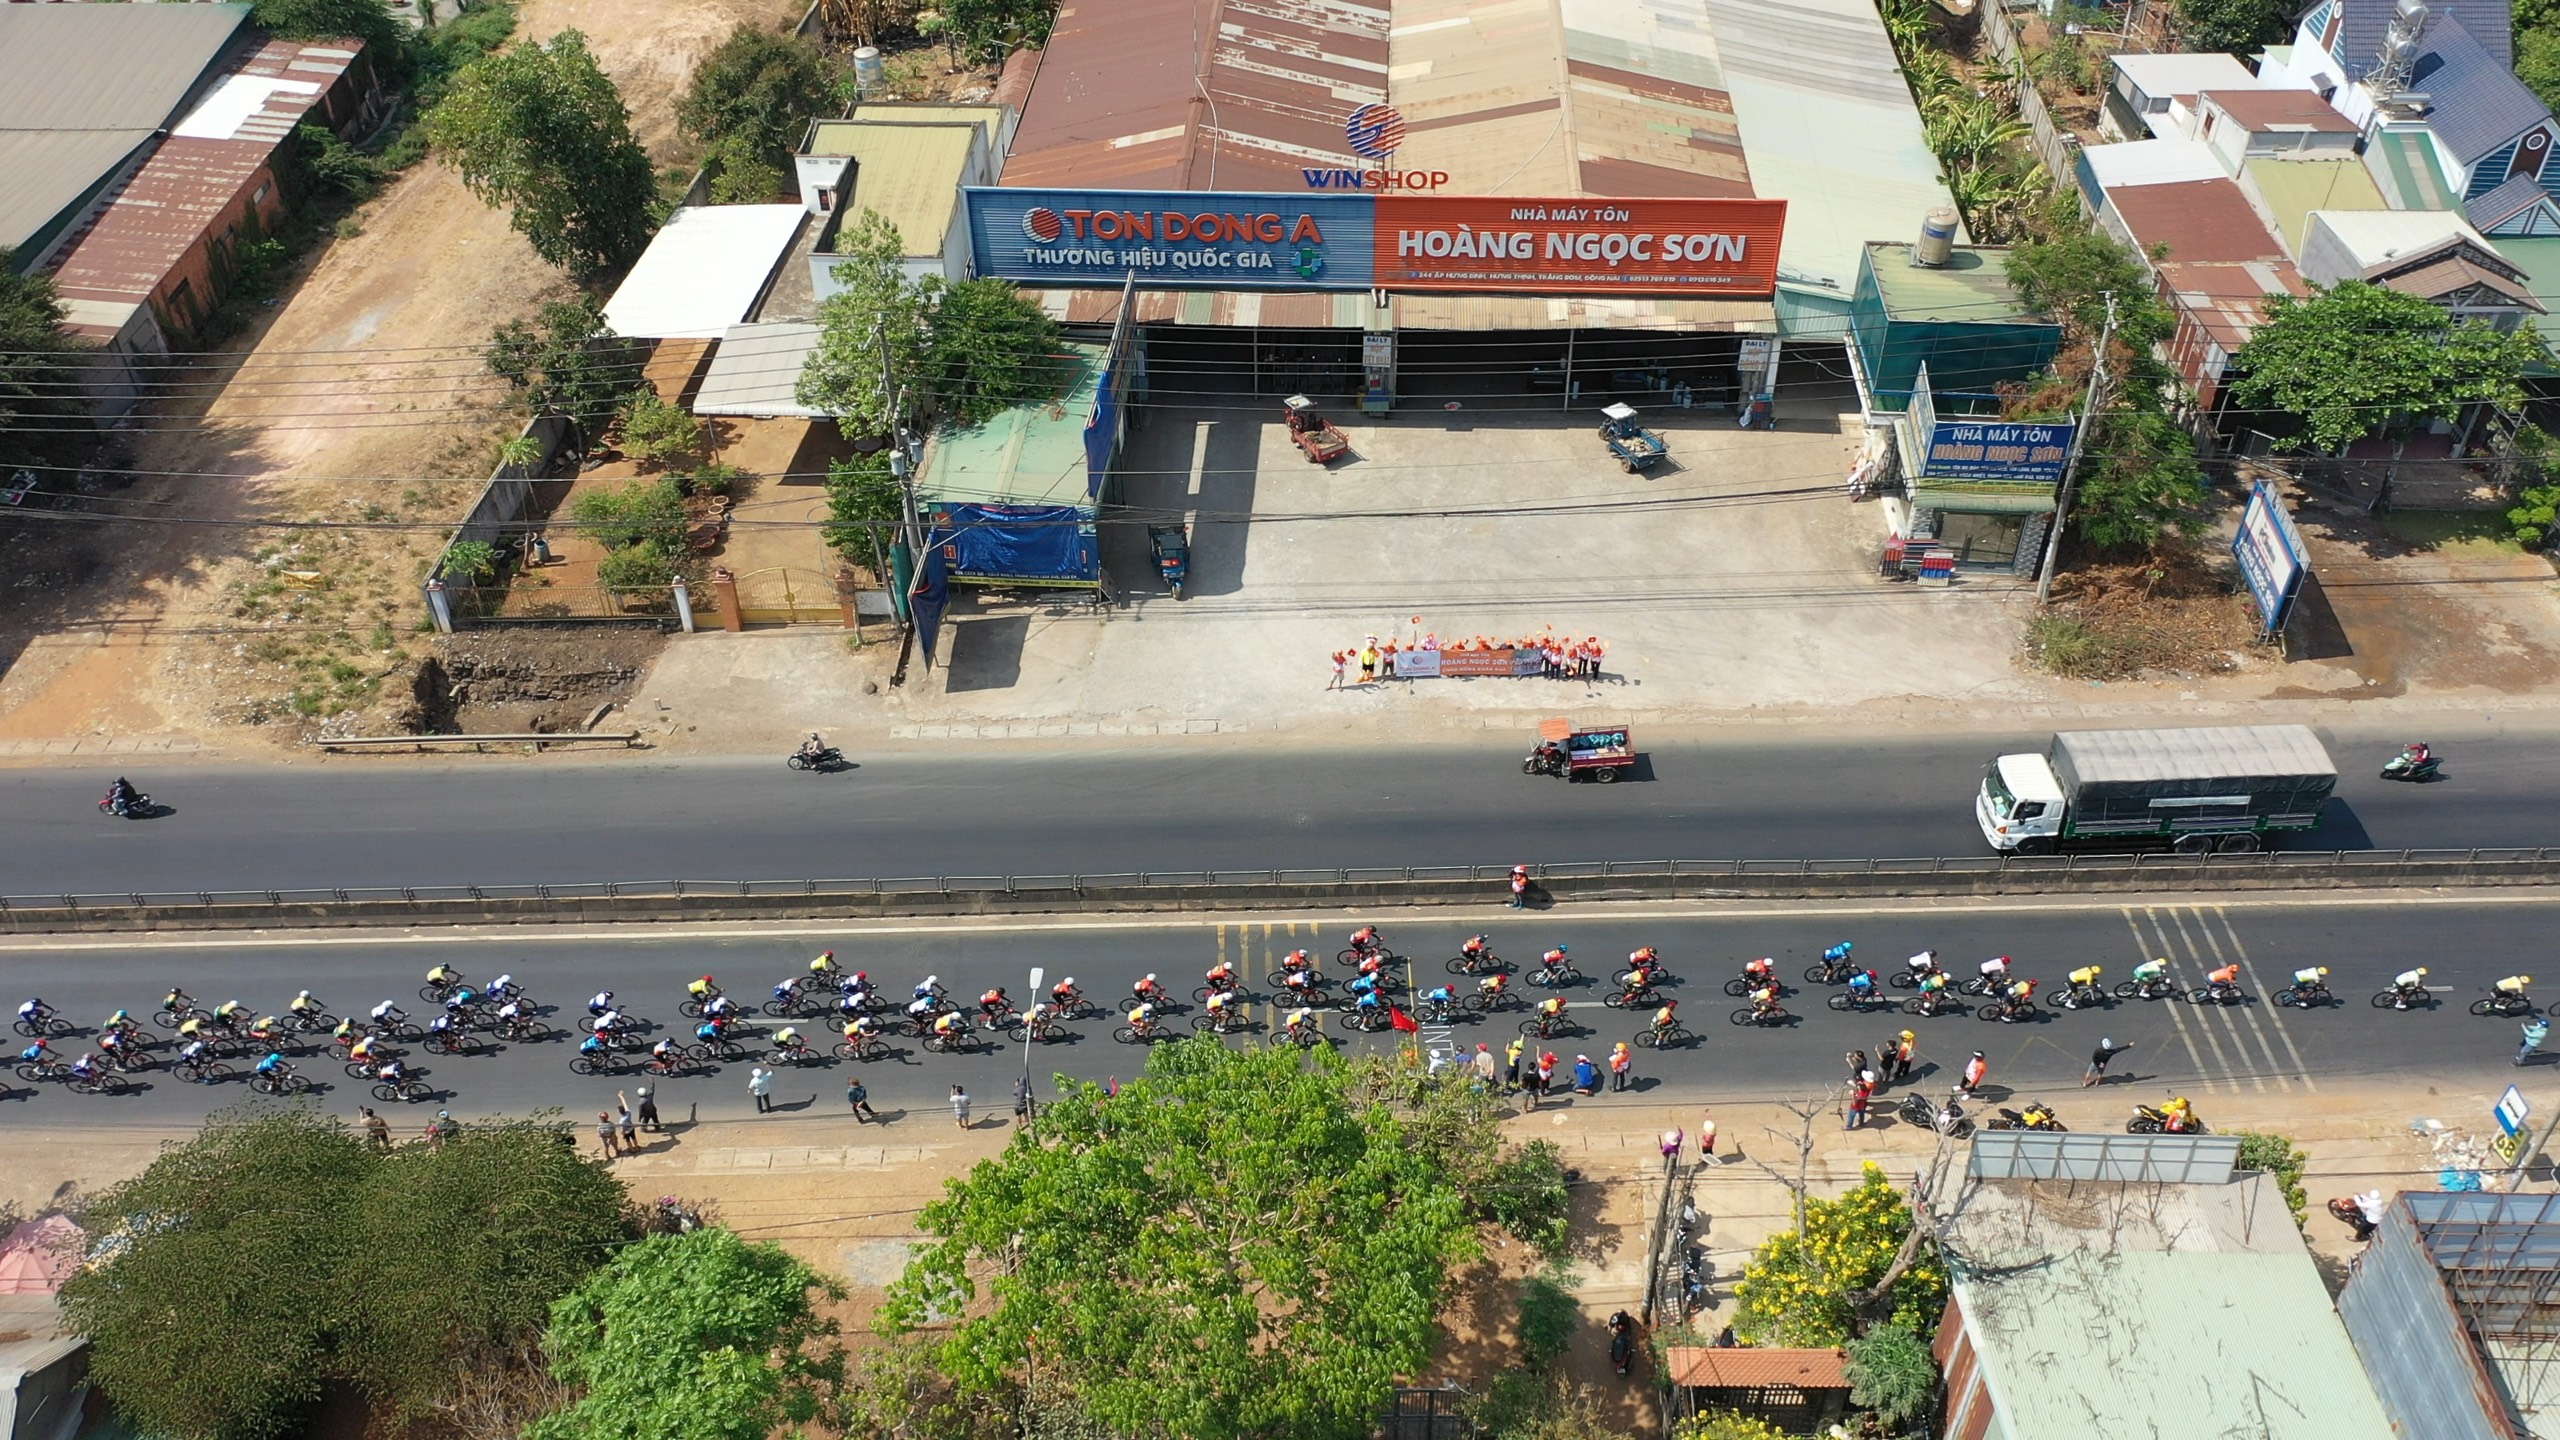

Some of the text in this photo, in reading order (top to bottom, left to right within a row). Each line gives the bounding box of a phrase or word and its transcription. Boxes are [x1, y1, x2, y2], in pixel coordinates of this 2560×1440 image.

[1301, 167, 1449, 190] WINSHOP
[1510, 205, 1630, 222] NHÀ MÁY TÔN
[1064, 210, 1322, 244] TON DONG A
[1398, 223, 1747, 267] HOÀNG NGỌC SƠN
[1023, 245, 1273, 271] THƯƠNG HIỆU QUỐC GIA
[1952, 425, 2053, 442] NHÀ MÁY TÔN
[1931, 442, 2064, 465] HOÀNG NGỌC SƠN
